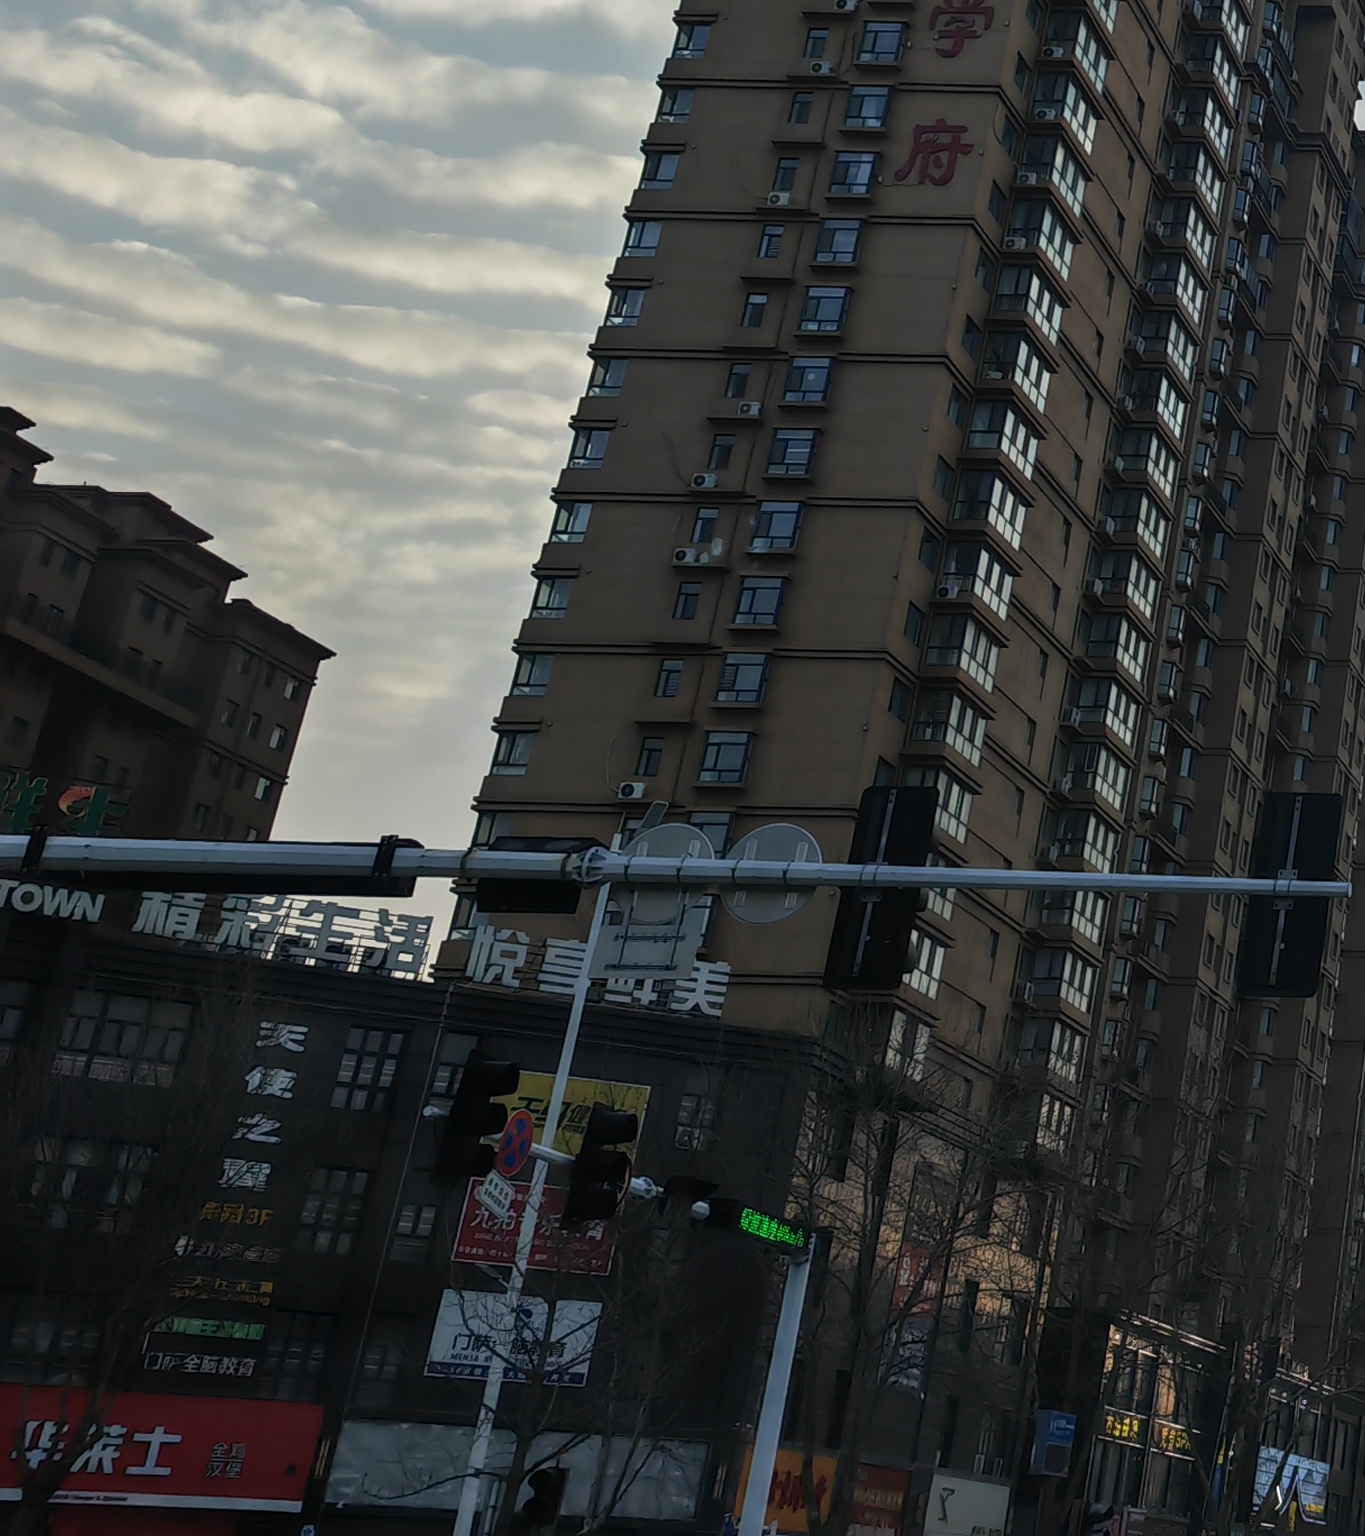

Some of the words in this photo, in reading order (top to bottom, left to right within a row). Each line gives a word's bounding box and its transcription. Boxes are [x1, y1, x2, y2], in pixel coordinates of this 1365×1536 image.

[0, 878, 107, 923] TOWN
[131, 890, 435, 976] 精彩生活
[469, 1207, 609, 1242] 九拍乐育
